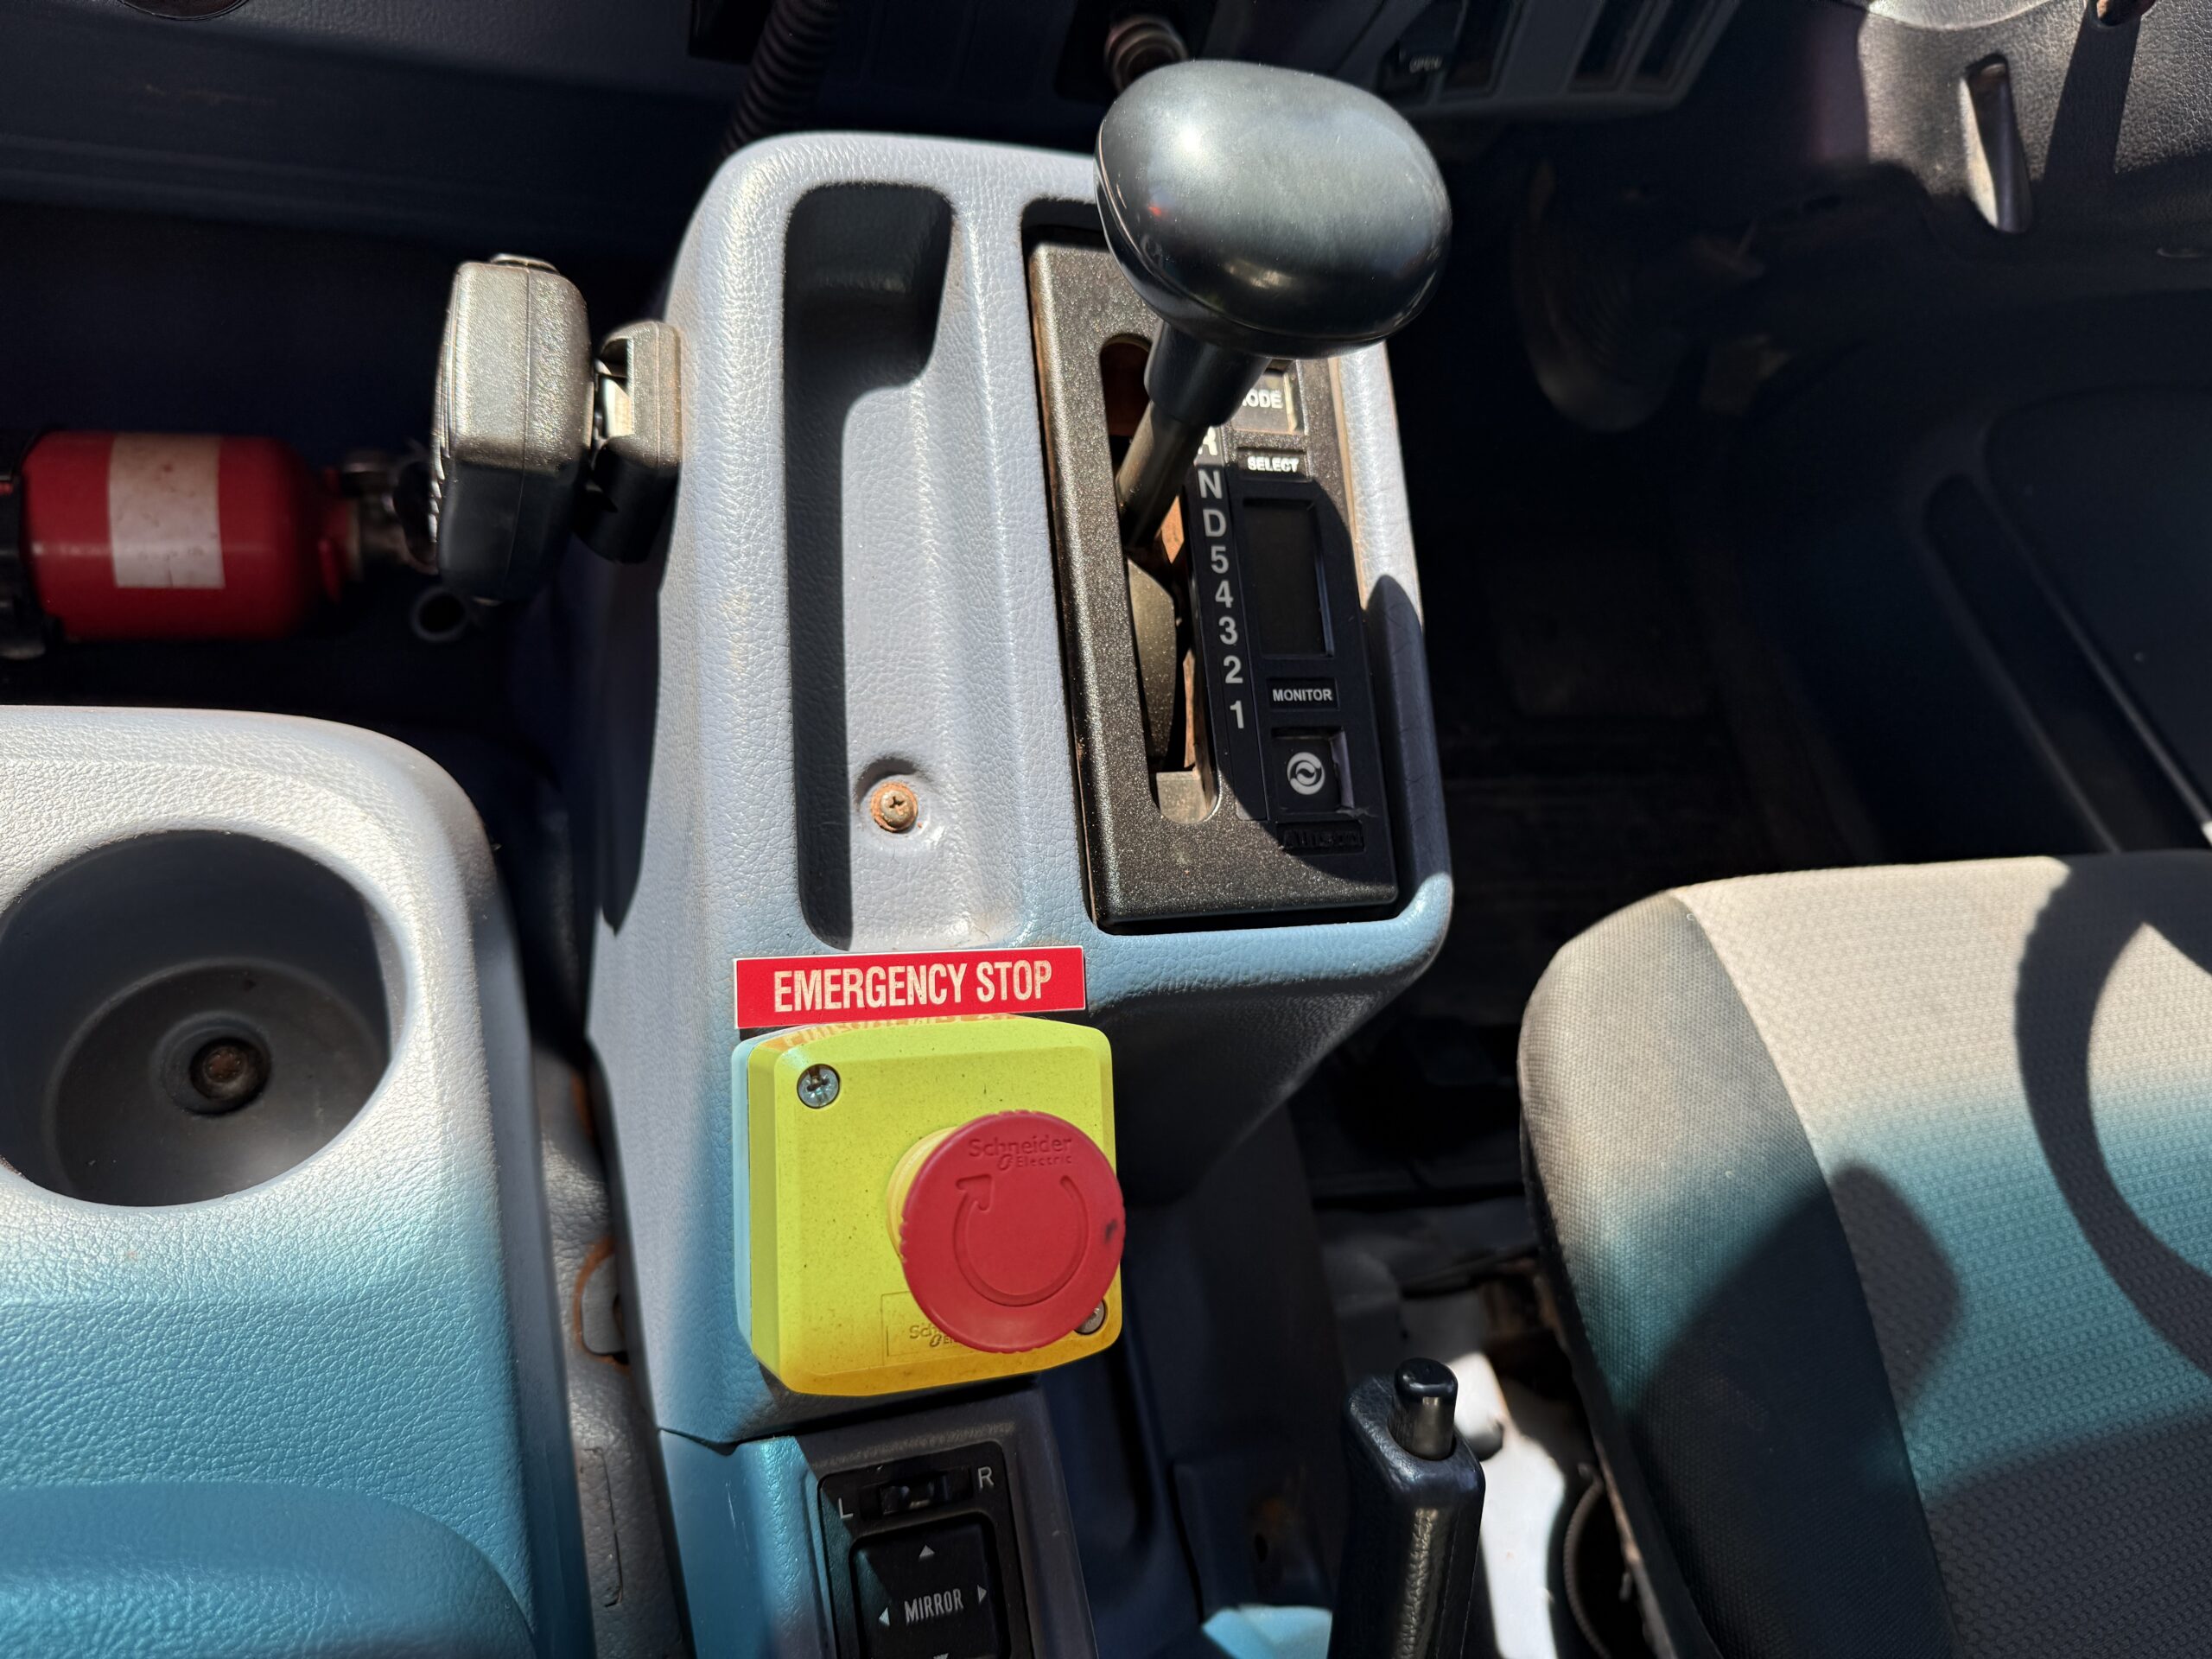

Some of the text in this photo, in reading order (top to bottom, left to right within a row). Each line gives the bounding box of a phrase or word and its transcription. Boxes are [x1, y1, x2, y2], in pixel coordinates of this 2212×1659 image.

[1242, 389, 1283, 409] ODE
[1247, 456, 1300, 473] SELECT
[1198, 469, 1223, 499] N
[1202, 508, 1227, 537] D
[1211, 545, 1230, 574] 5
[1215, 580, 1234, 608] 4
[1218, 616, 1238, 645] 3
[1223, 655, 1244, 684] 2
[1272, 688, 1333, 702] MONITOR
[1230, 700, 1245, 729] 1
[773, 959, 1053, 1014] EMERGENCY STOP
[968, 1134, 1072, 1158] Schneider
[1016, 1154, 1072, 1168] Electric
[977, 1465, 995, 1489] R
[838, 1497, 854, 1520] L
[904, 1588, 964, 1624] MIRROR
